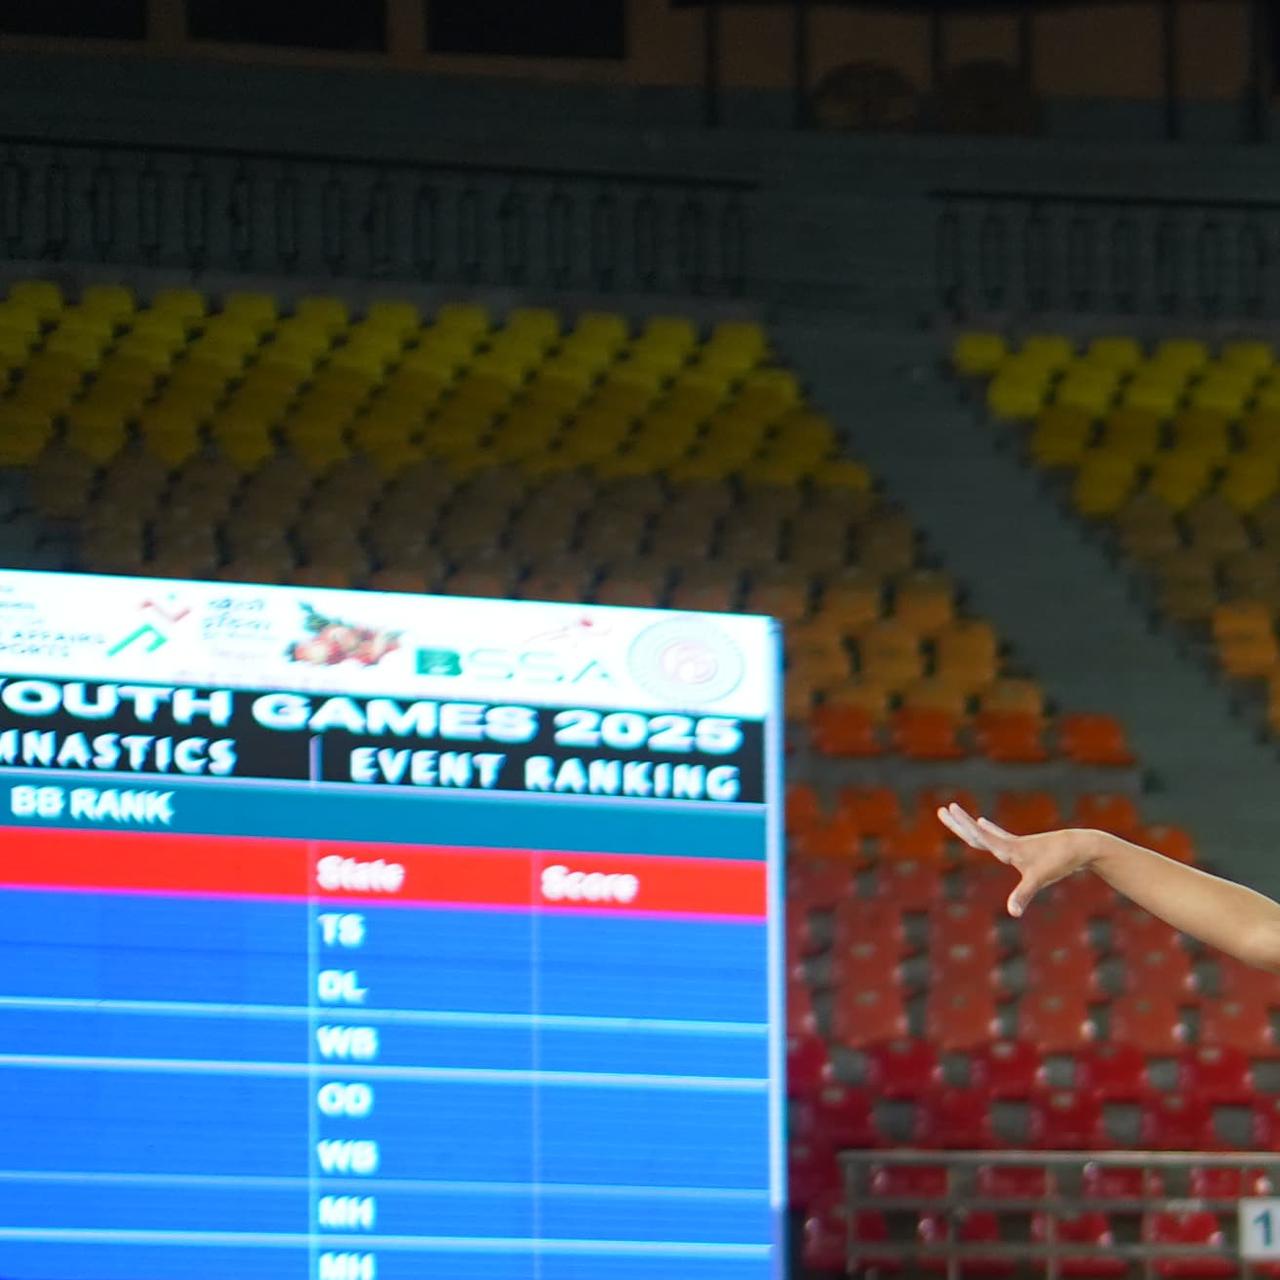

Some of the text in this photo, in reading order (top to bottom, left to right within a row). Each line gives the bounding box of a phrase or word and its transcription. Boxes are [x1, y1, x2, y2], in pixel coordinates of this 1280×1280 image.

[0, 678, 745, 755] OUTH GAMES 2025
[350, 747, 506, 789] EVENT
[524, 755, 741, 801] RANKING
[10, 785, 176, 825] BB RANK
[316, 855, 639, 903] State Score
[317, 912, 366, 948] TS
[316, 1024, 379, 1060] WB
[317, 1139, 379, 1176] WB
[317, 1197, 376, 1230] MH
